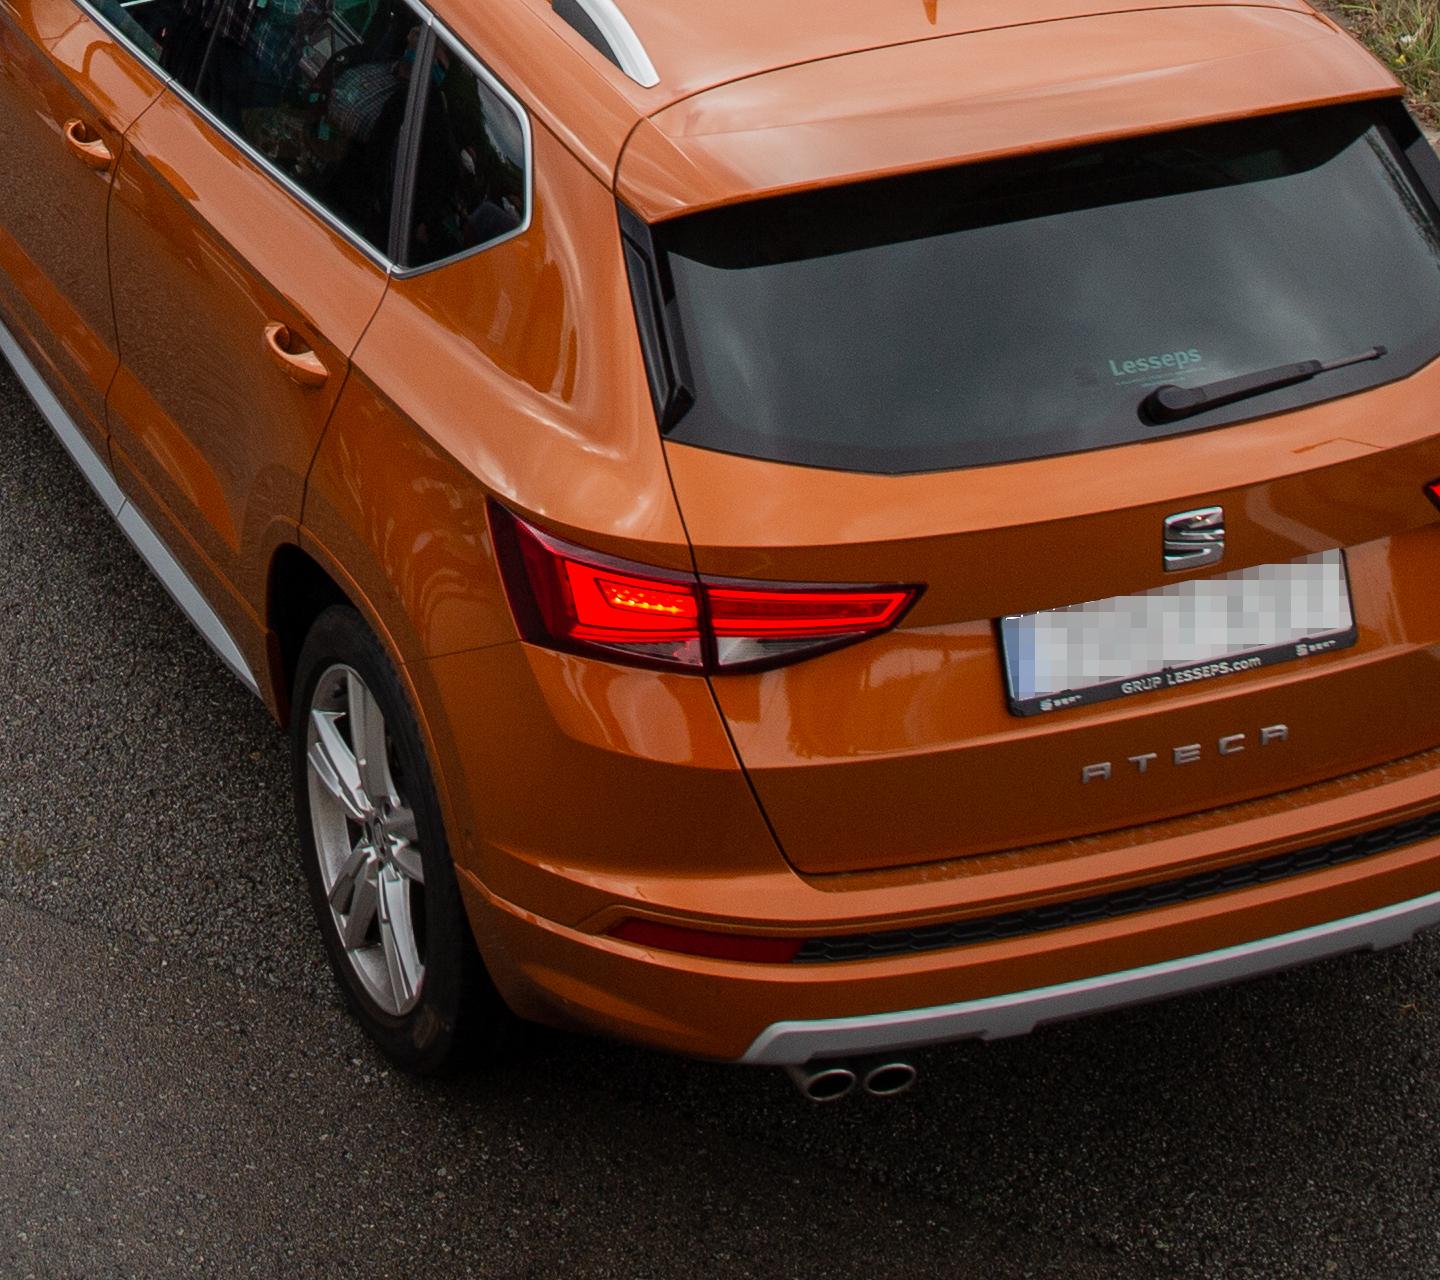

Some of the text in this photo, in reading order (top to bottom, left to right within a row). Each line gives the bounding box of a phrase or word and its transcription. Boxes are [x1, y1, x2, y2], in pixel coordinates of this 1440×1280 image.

[1108, 347, 1202, 377] Lesseps
[1121, 655, 1262, 695] GRUP LESSEPS.com
[1082, 723, 1289, 784] ATECA
